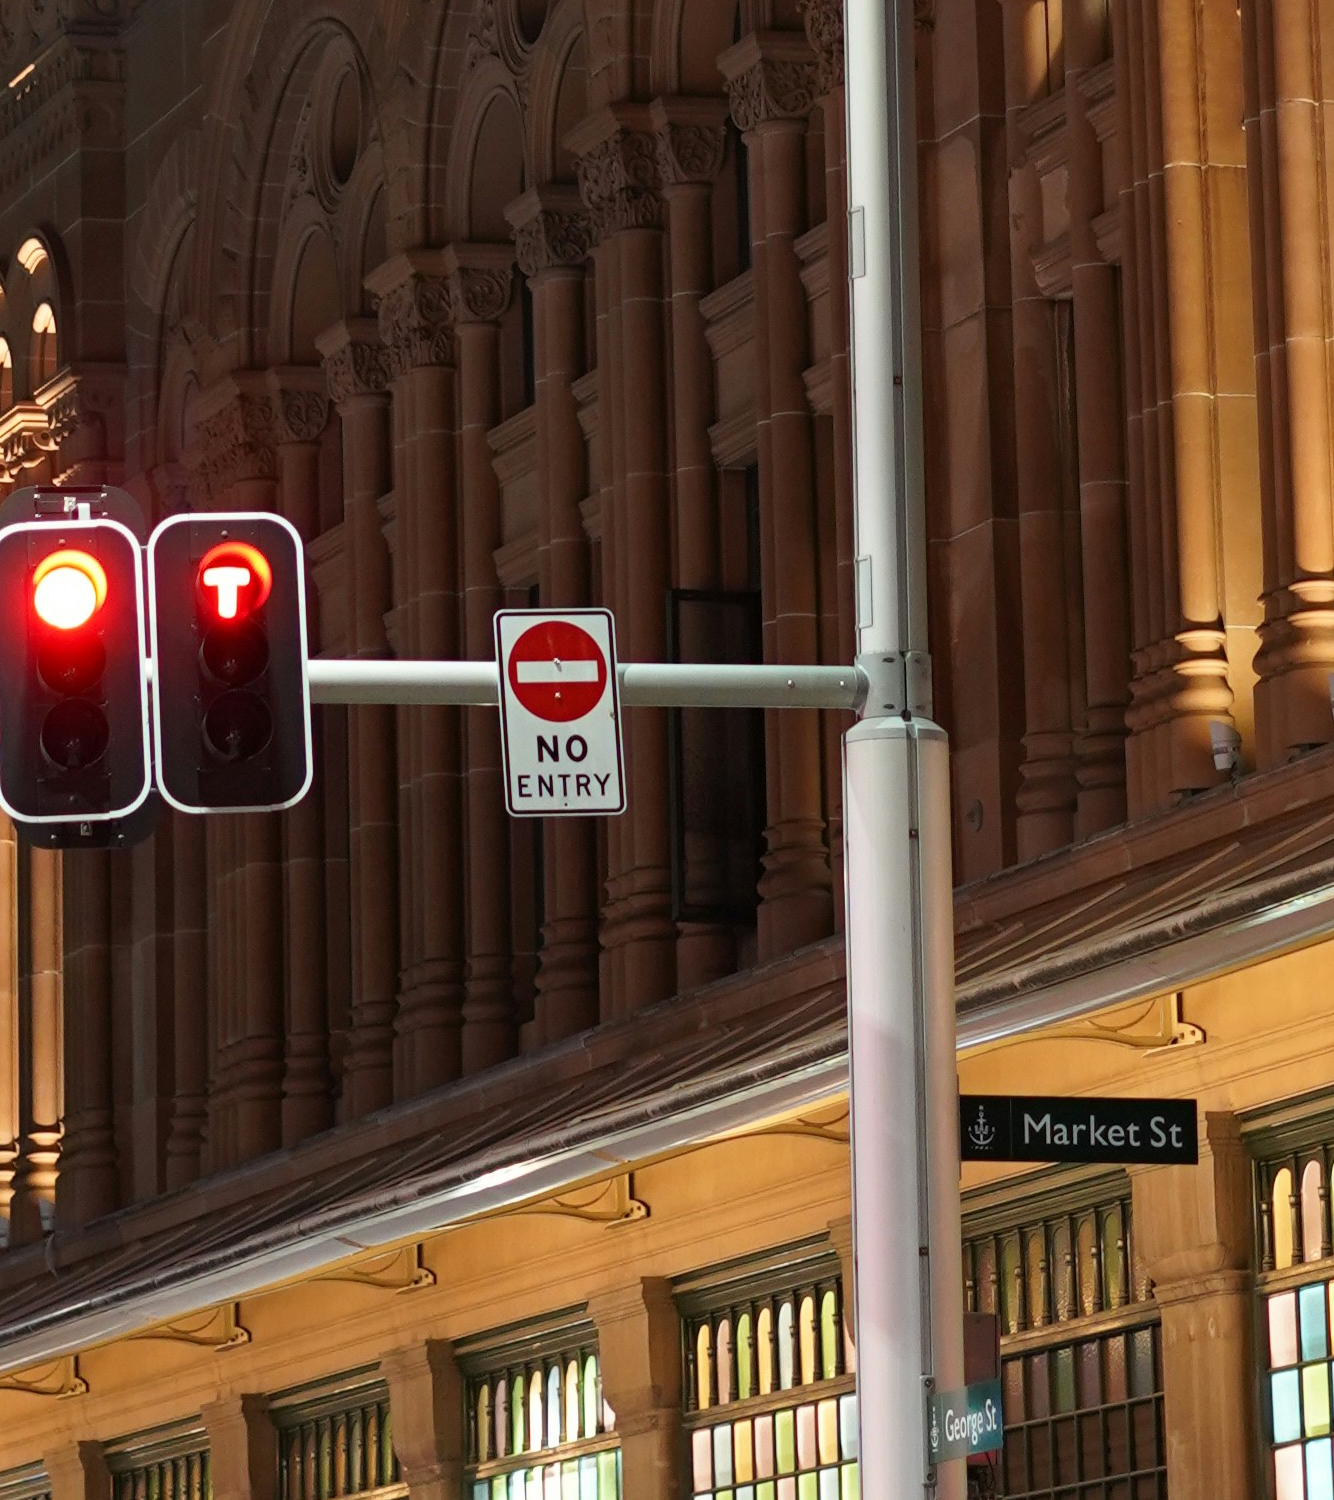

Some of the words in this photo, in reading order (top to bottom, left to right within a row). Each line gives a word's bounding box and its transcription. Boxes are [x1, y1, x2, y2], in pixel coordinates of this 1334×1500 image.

[537, 734, 588, 762] NO
[518, 773, 610, 797] ENTRY
[1023, 1113, 1141, 1147] Market
[1150, 1116, 1183, 1148] St
[945, 1409, 983, 1445] George
[985, 1398, 997, 1432] St
